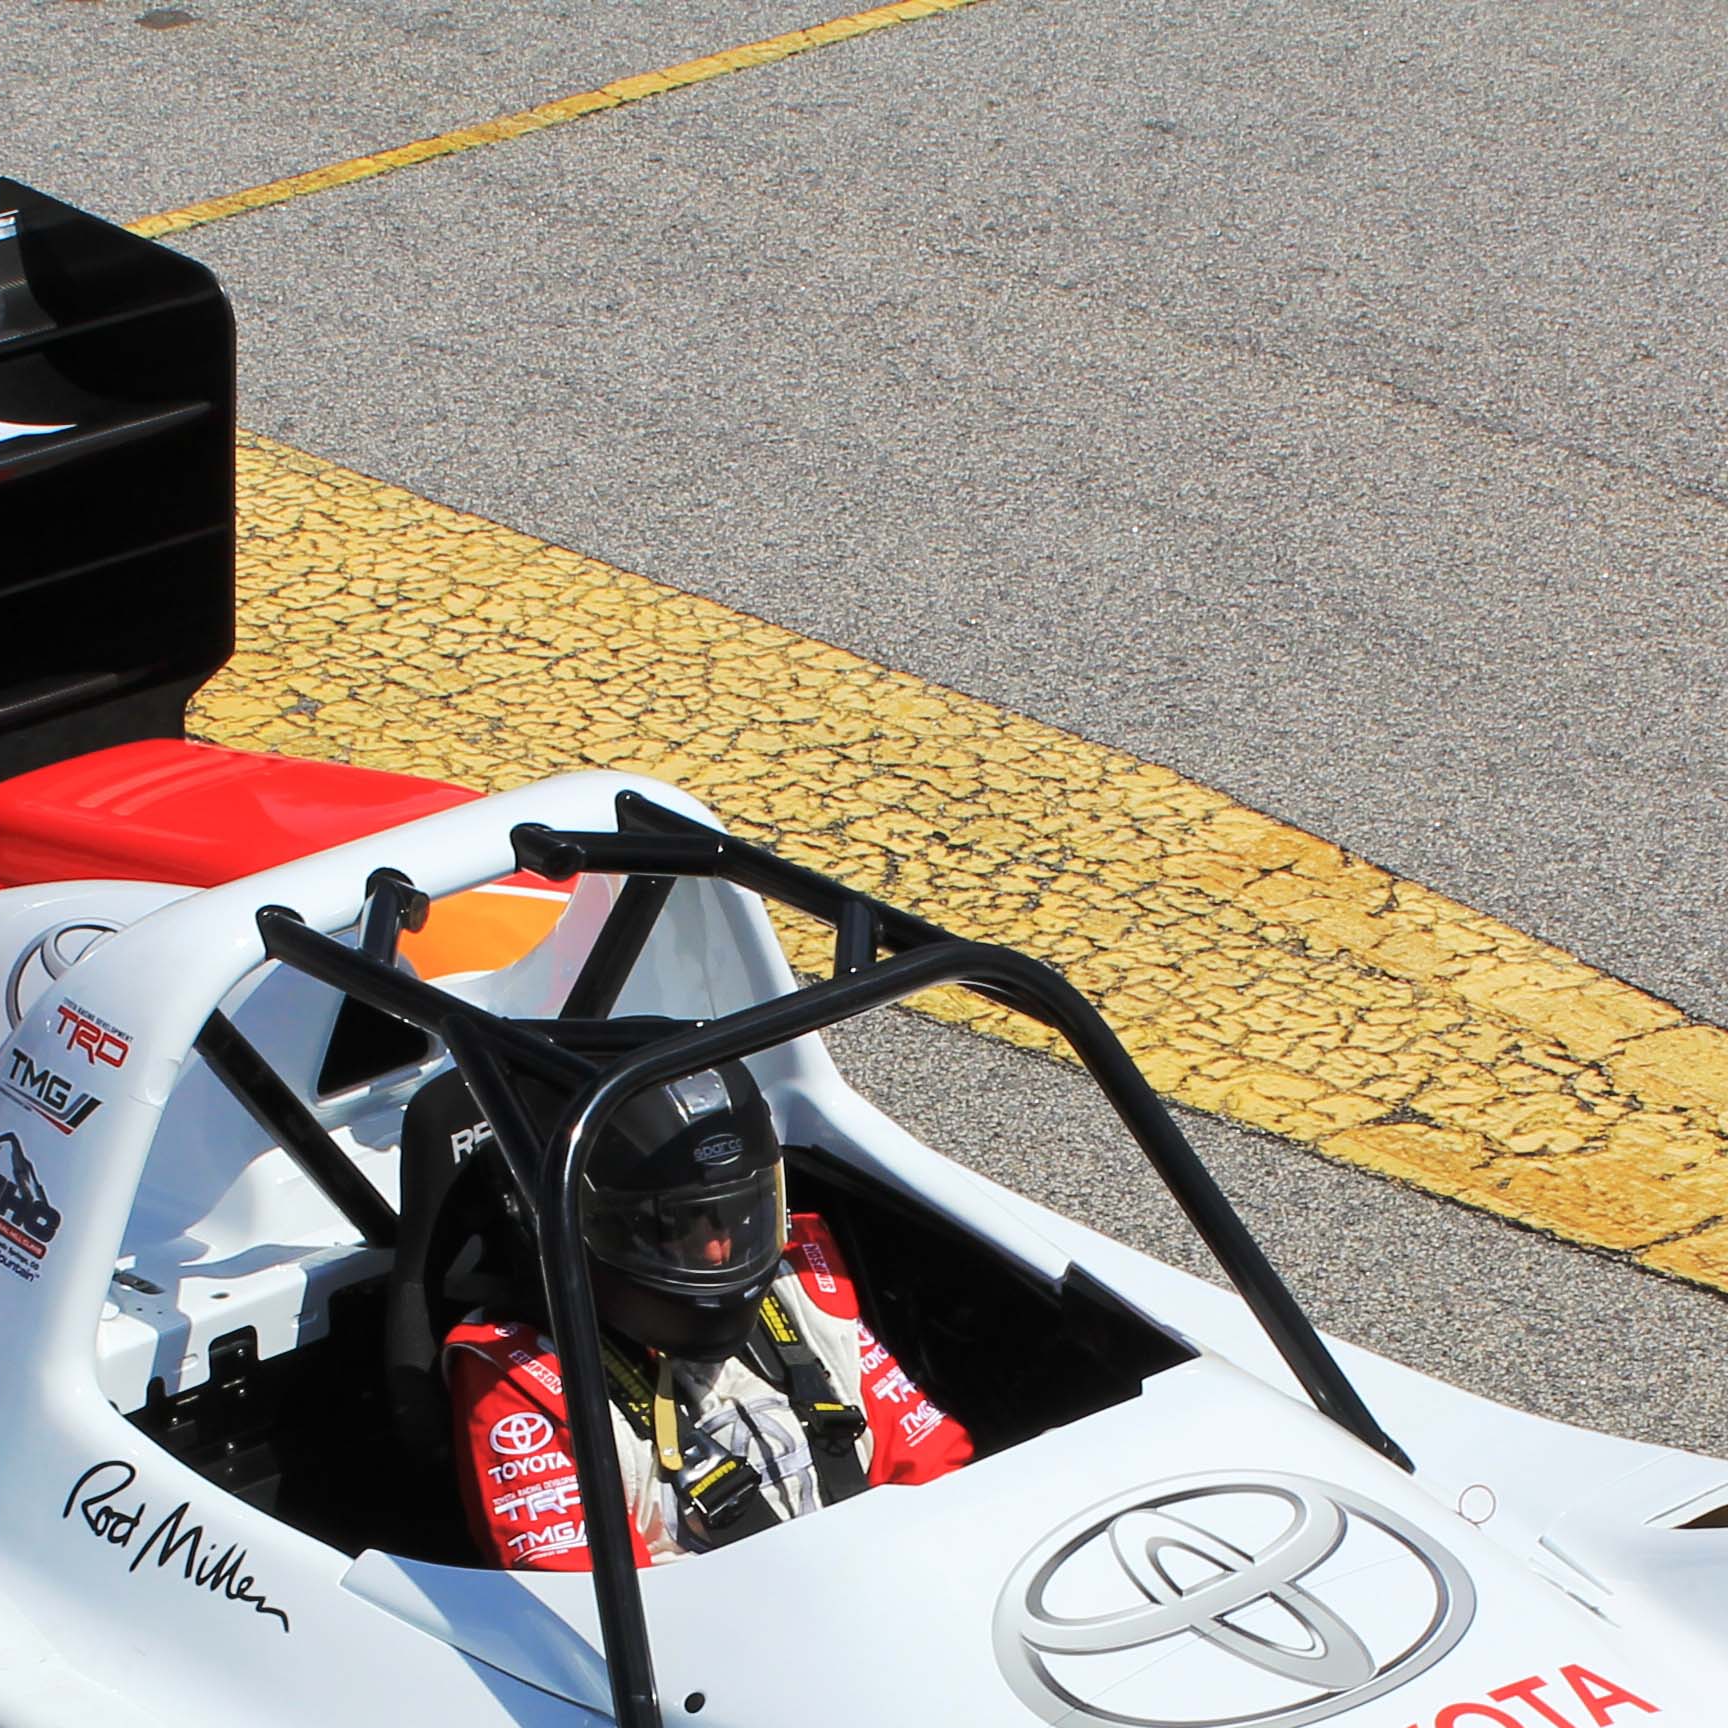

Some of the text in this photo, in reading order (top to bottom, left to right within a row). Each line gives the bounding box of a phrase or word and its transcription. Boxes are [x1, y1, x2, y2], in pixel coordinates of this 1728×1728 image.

[57, 1005, 129, 1068] TRD
[10, 1047, 73, 1111] TMG
[510, 1351, 563, 1395] SIMPSON
[858, 1342, 889, 1374] TOYO
[488, 1451, 571, 1484] TOYOTA
[63, 1460, 290, 1632] Rod Millen
[507, 1520, 576, 1553] TMG
